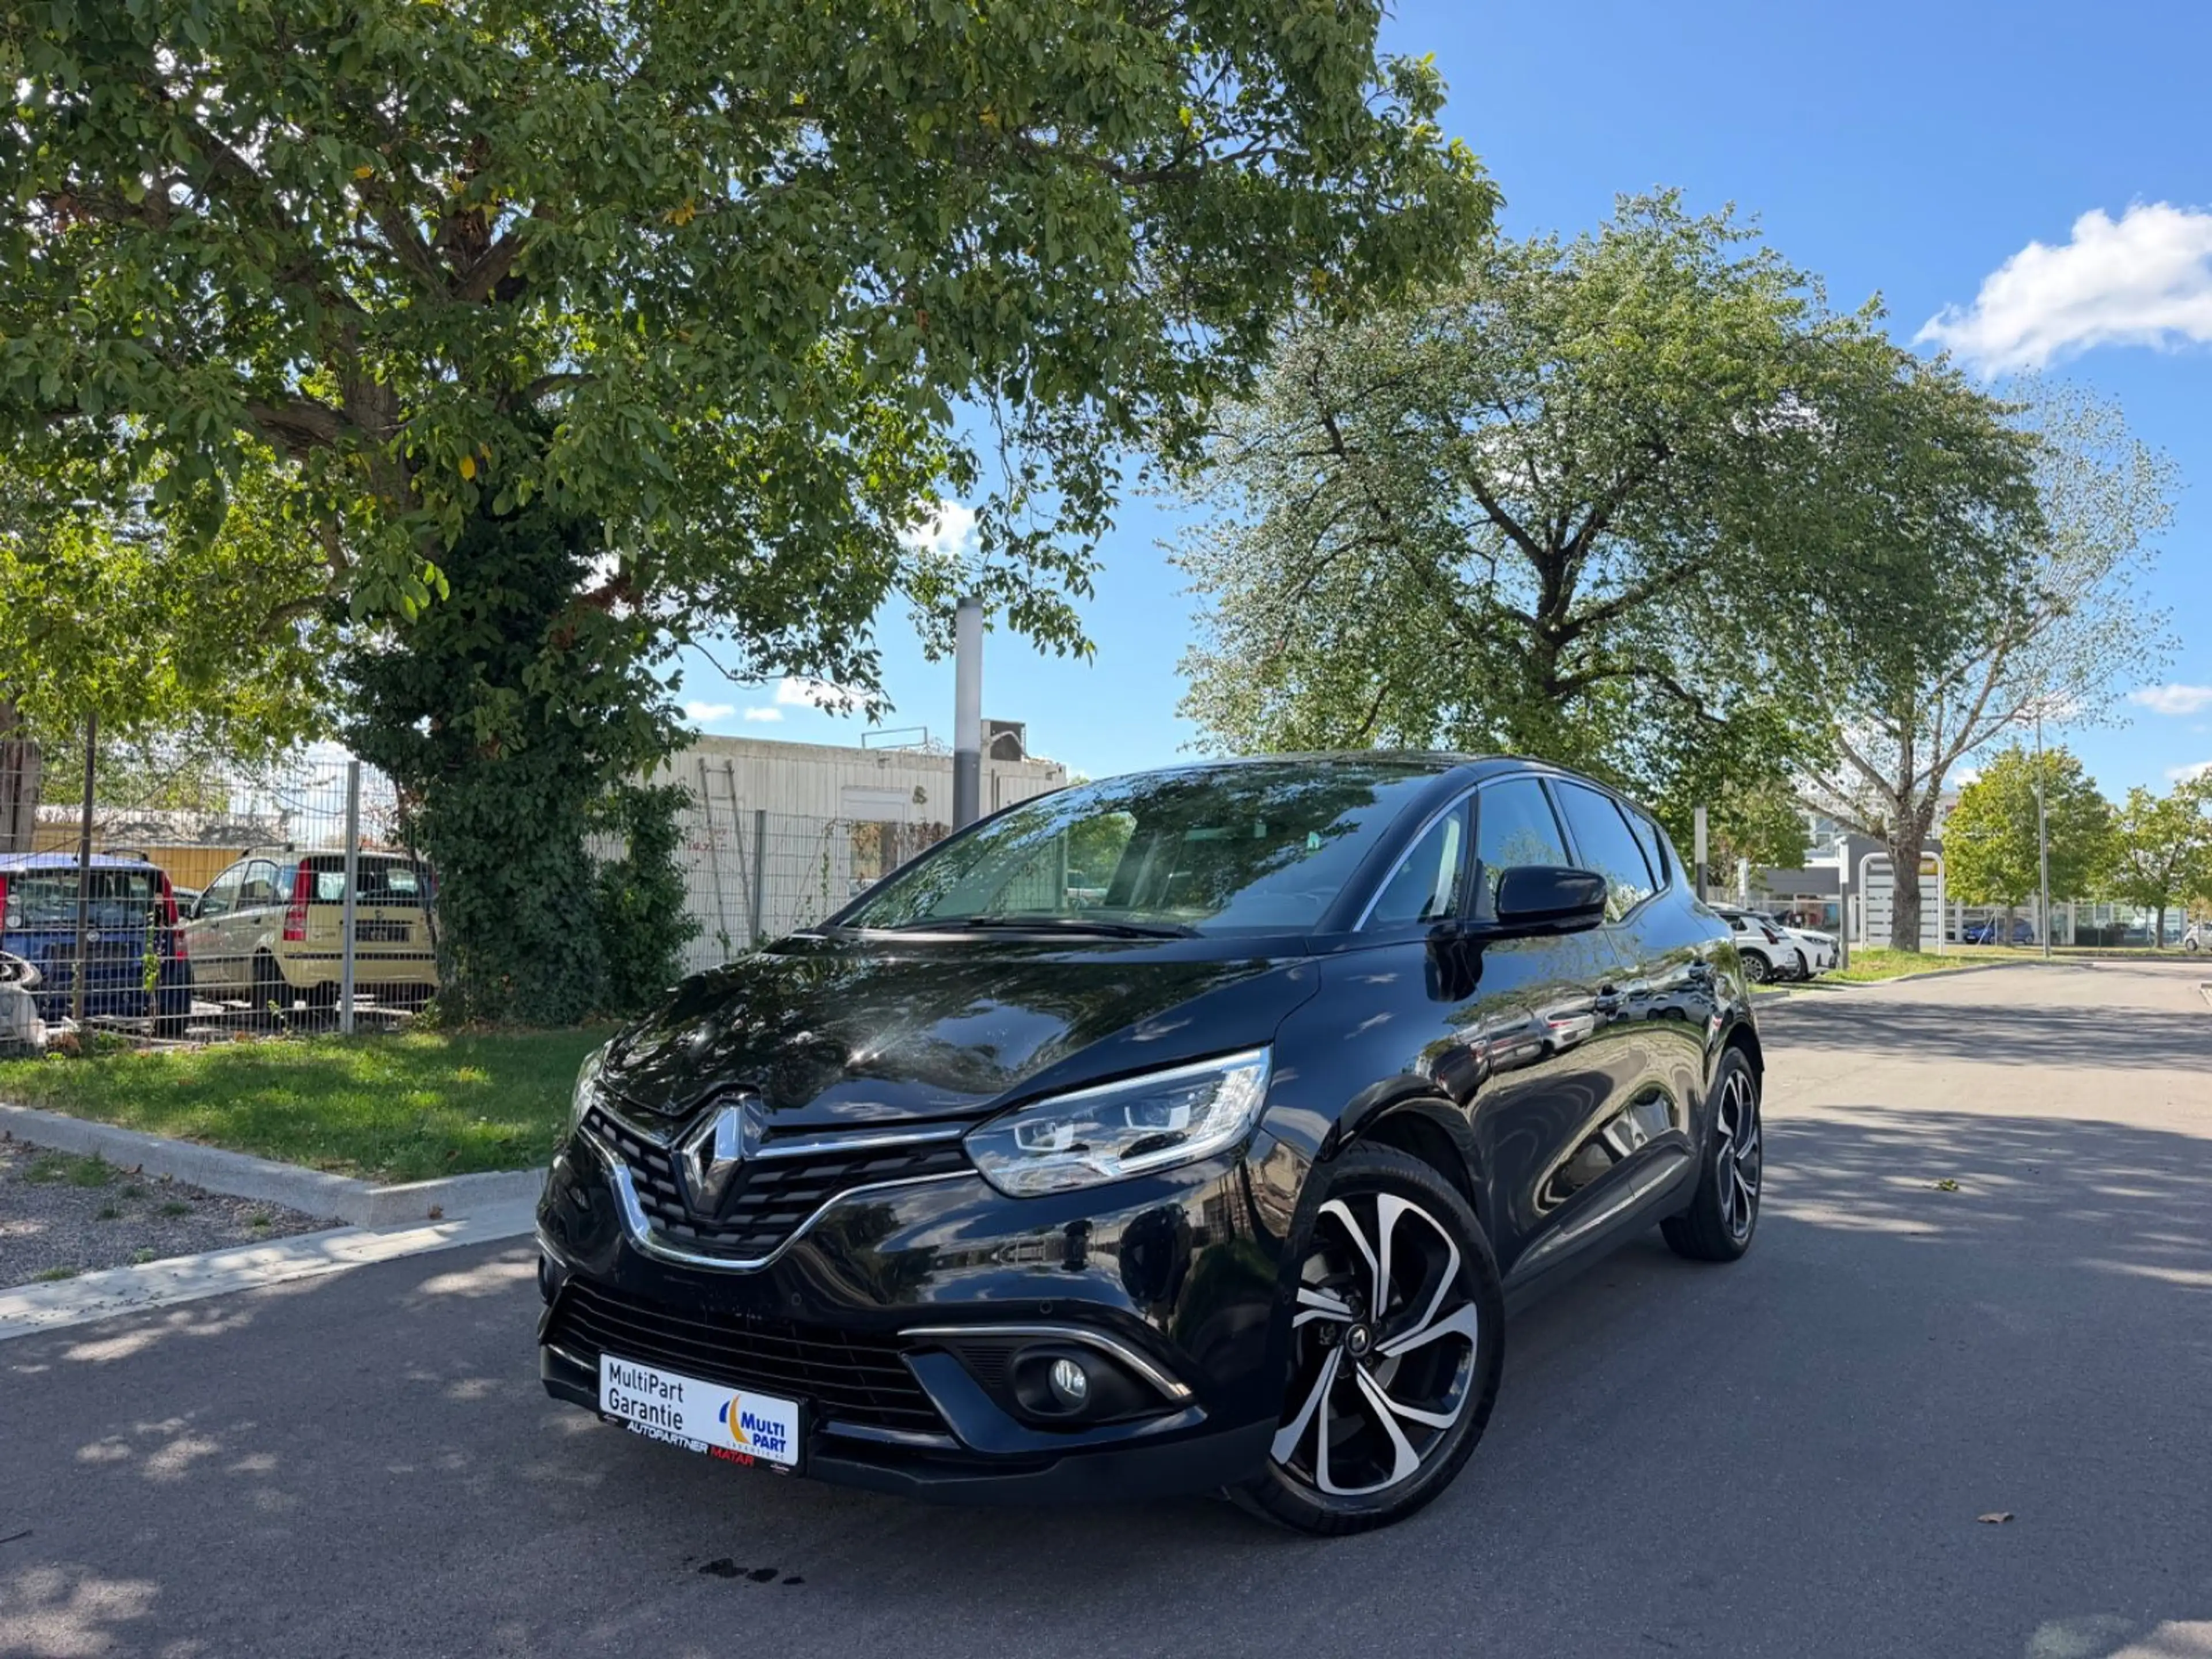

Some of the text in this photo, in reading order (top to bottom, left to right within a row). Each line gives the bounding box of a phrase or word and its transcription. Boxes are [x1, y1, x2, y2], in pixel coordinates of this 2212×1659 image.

[609, 1362, 684, 1404] MultiPart
[608, 1387, 684, 1431] Garantie
[626, 1421, 709, 1455] AUTOPARTNER
[752, 1432, 786, 1453] PART
[711, 1446, 755, 1467] MATAR
